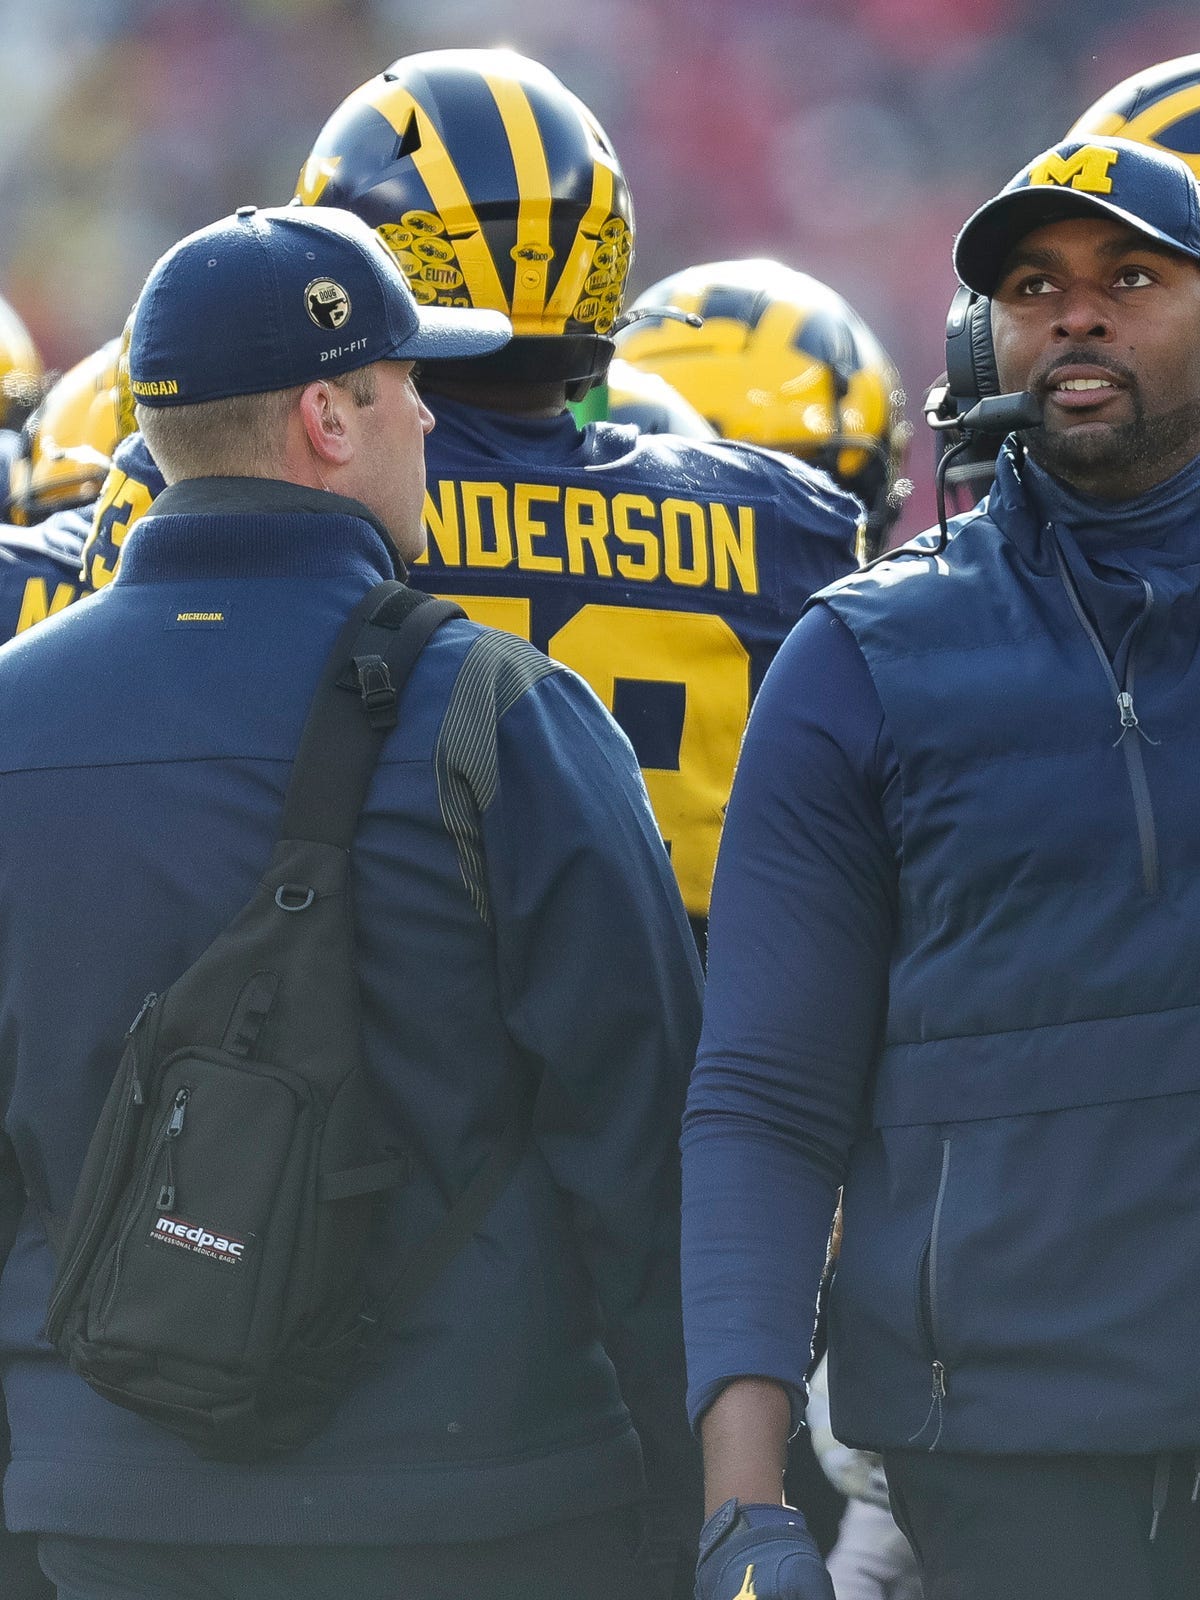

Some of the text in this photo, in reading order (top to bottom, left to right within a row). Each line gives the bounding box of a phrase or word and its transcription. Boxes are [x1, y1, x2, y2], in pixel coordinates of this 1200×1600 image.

[1029, 145, 1118, 194] M
[320, 338, 367, 361] DRI-FIT
[149, 1231, 237, 1265] PROFESSIONAL MEDICAL BAGS
[155, 1217, 245, 1256] medpac
